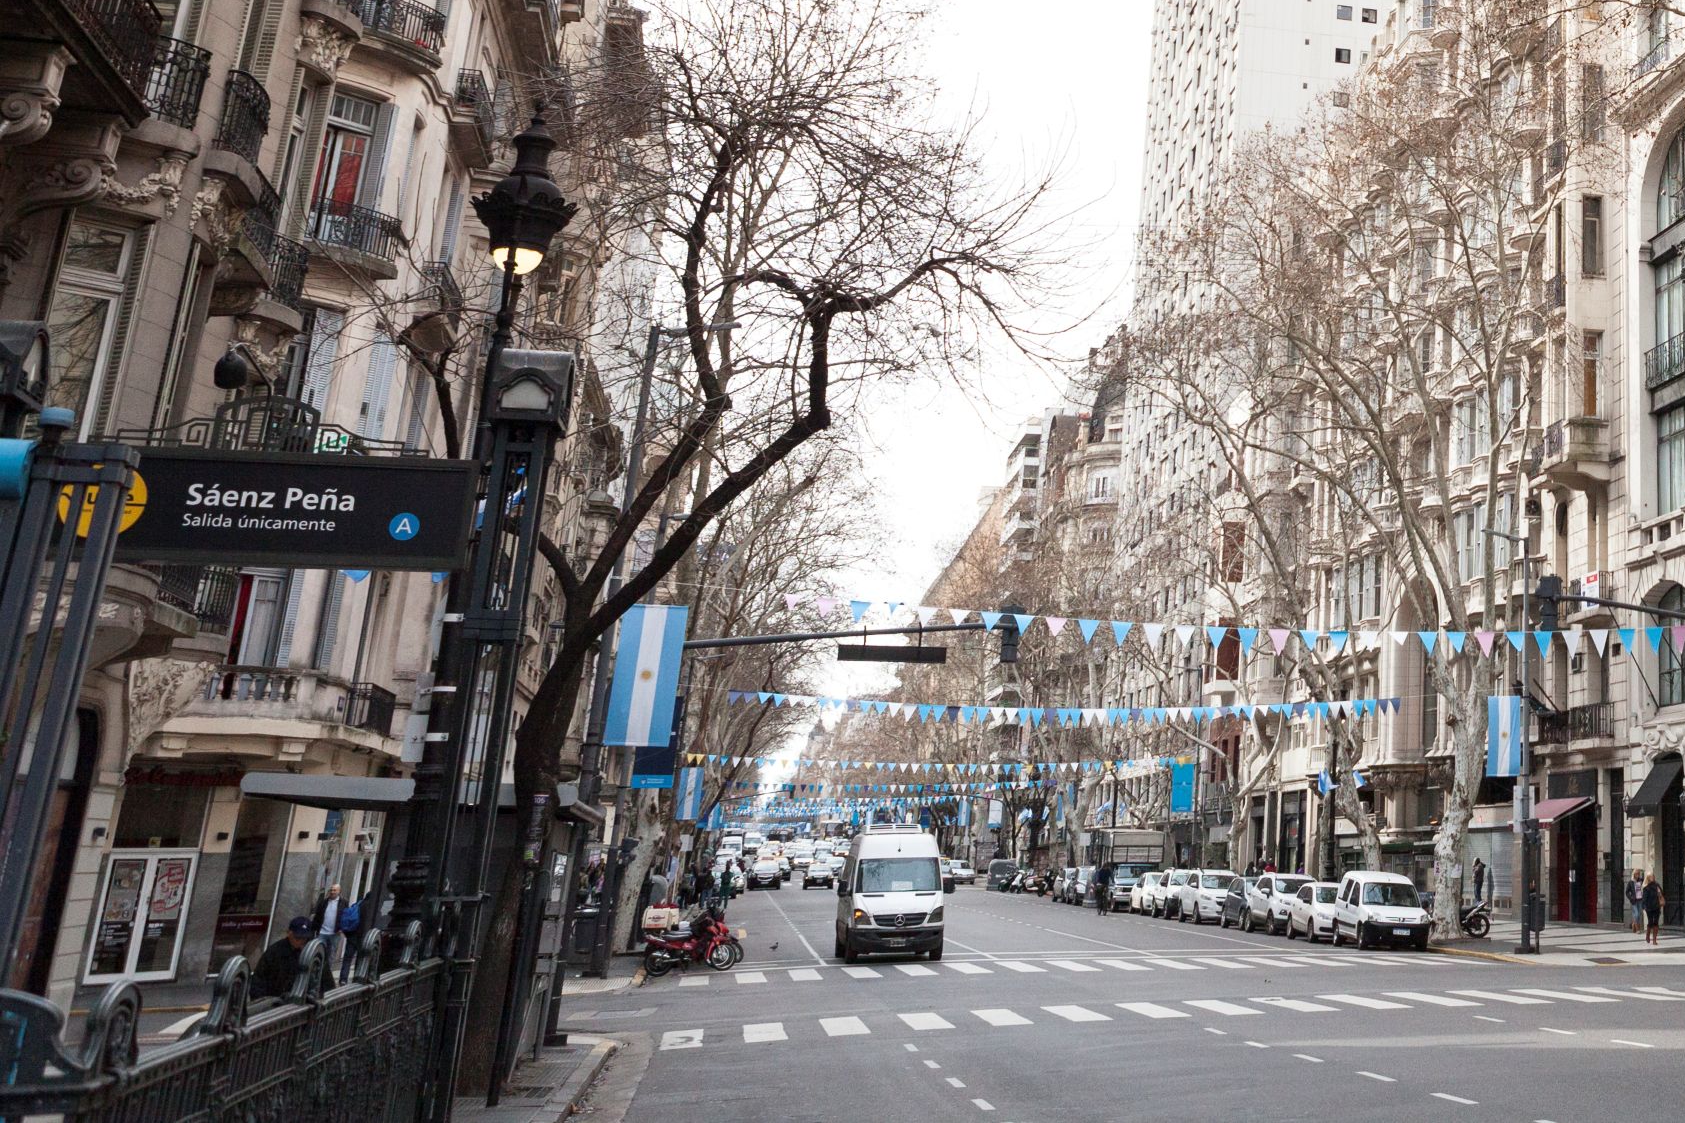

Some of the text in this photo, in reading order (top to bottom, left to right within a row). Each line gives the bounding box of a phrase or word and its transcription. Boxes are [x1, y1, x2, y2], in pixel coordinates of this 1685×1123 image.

[186, 483, 356, 512] Sáenz Peña
[182, 512, 336, 532] Salida únicamente
[395, 517, 412, 534] A
